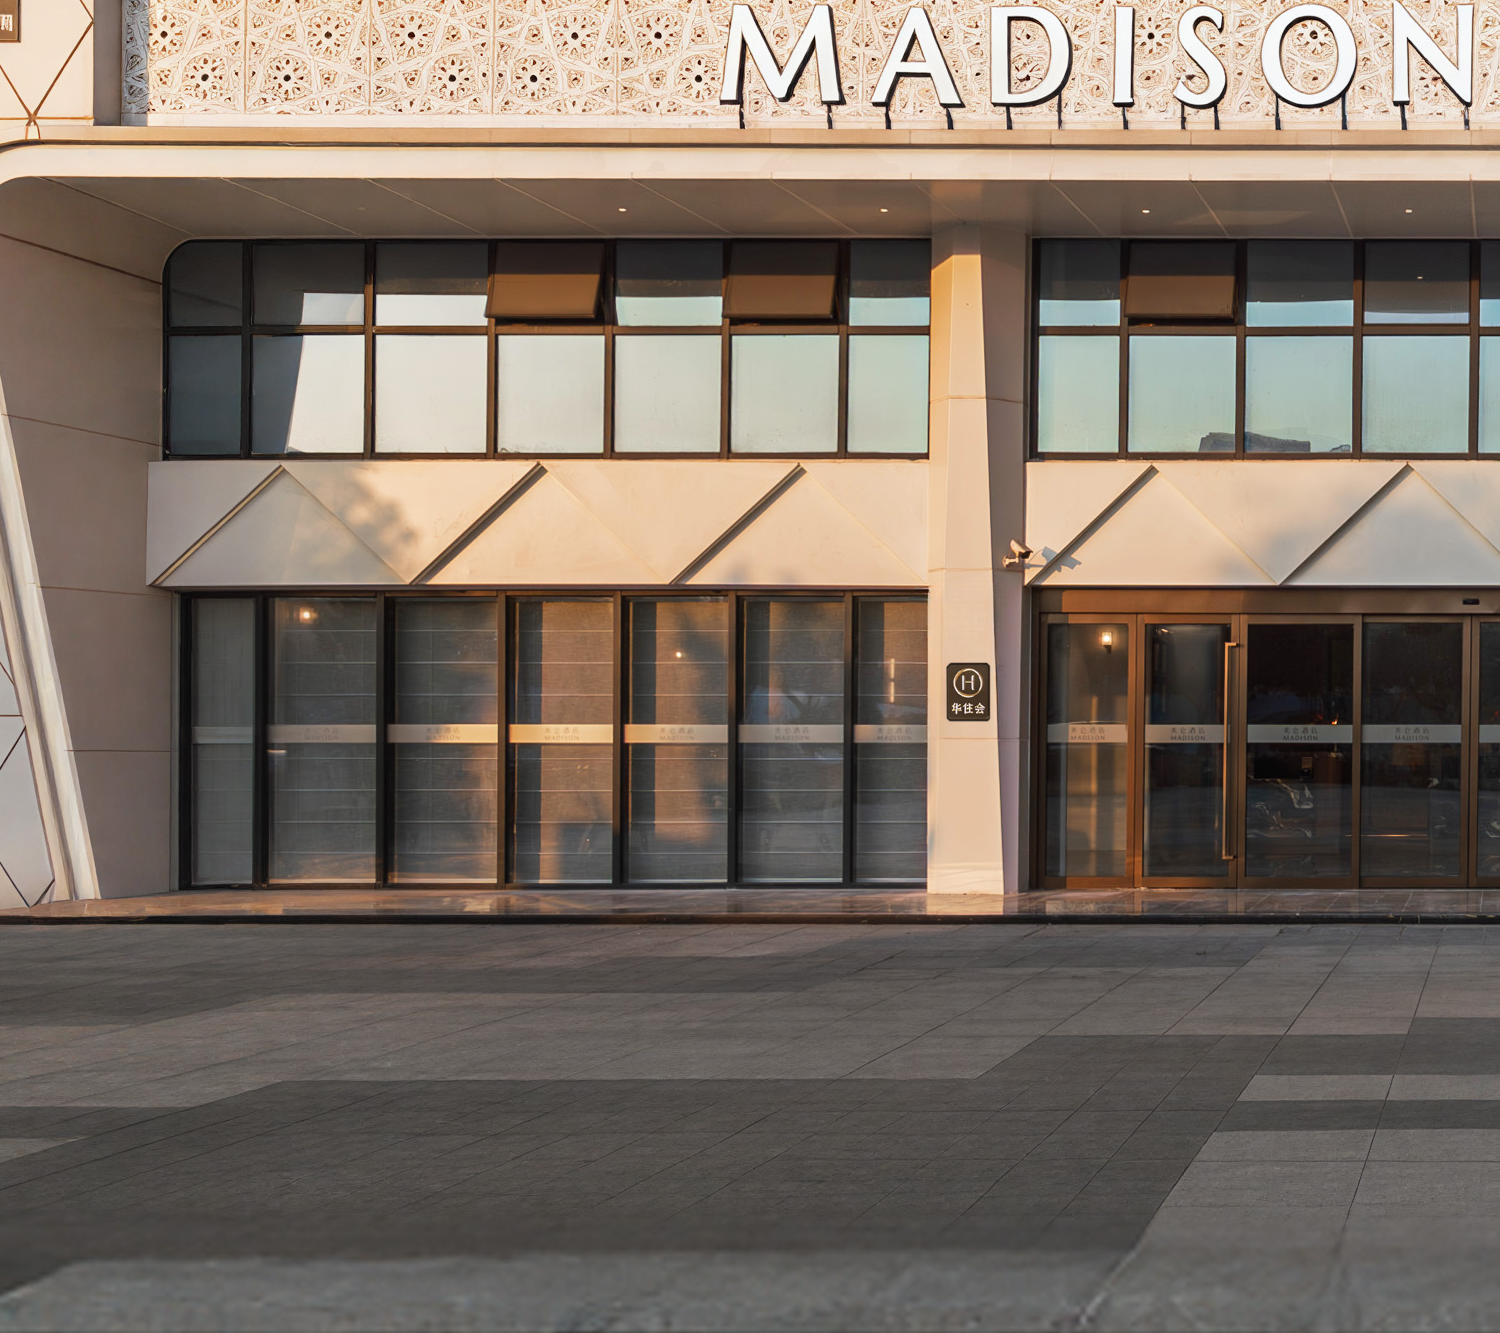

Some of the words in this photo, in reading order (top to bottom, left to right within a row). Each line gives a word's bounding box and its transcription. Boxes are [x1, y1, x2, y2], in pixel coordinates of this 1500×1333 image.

[719, 2, 1474, 108] MADISON
[951, 702, 986, 714] 华住会
